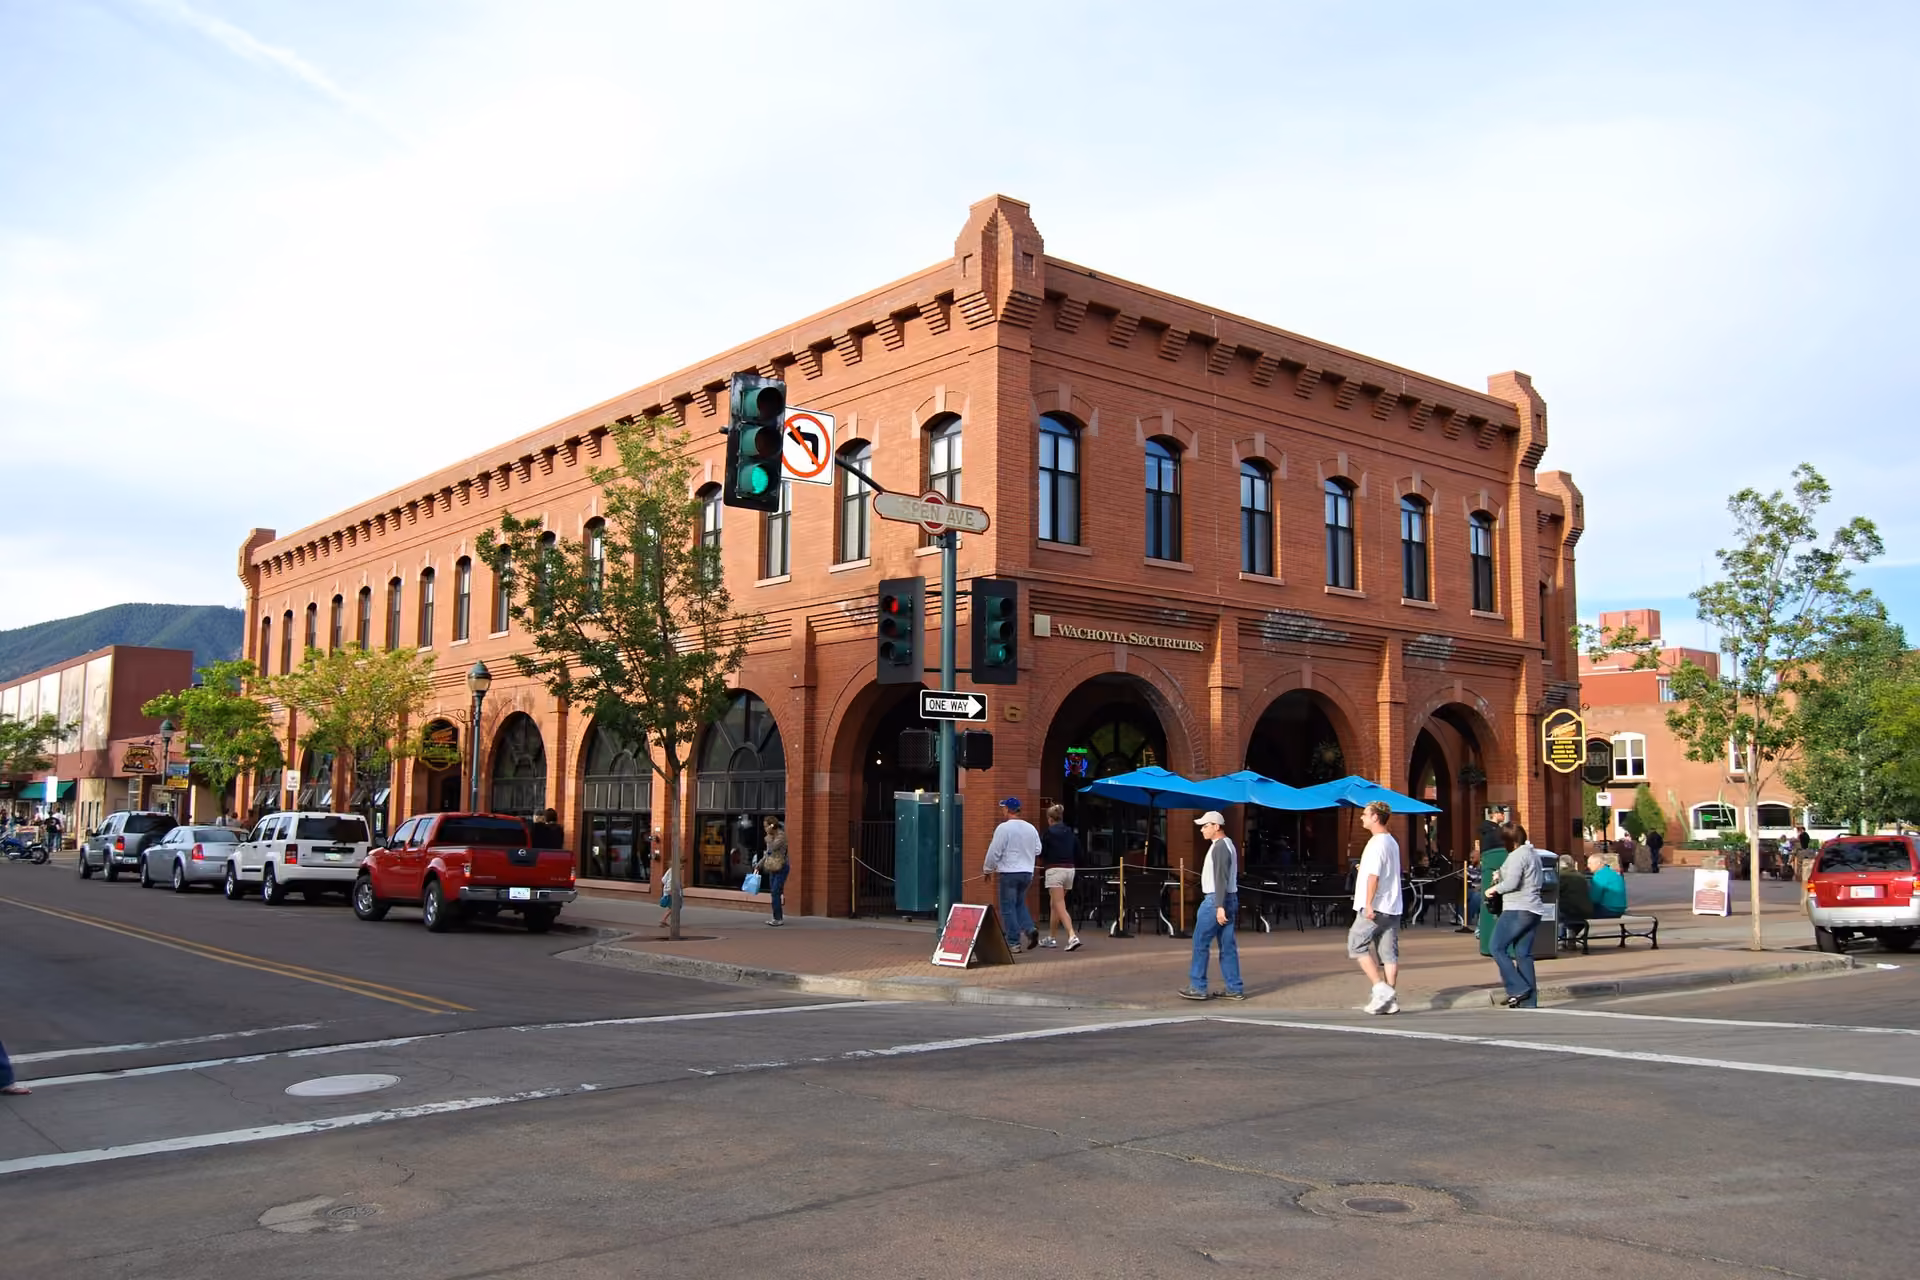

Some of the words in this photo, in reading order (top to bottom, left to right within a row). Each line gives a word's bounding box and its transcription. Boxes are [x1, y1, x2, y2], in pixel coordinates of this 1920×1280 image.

[896, 497, 940, 521] SPEN
[946, 508, 975, 526] AVE
[1056, 623, 1128, 644] WACHOVIA
[1128, 632, 1205, 652] SECURITIES
[929, 699, 947, 711] ONE
[950, 701, 969, 712] WAY
